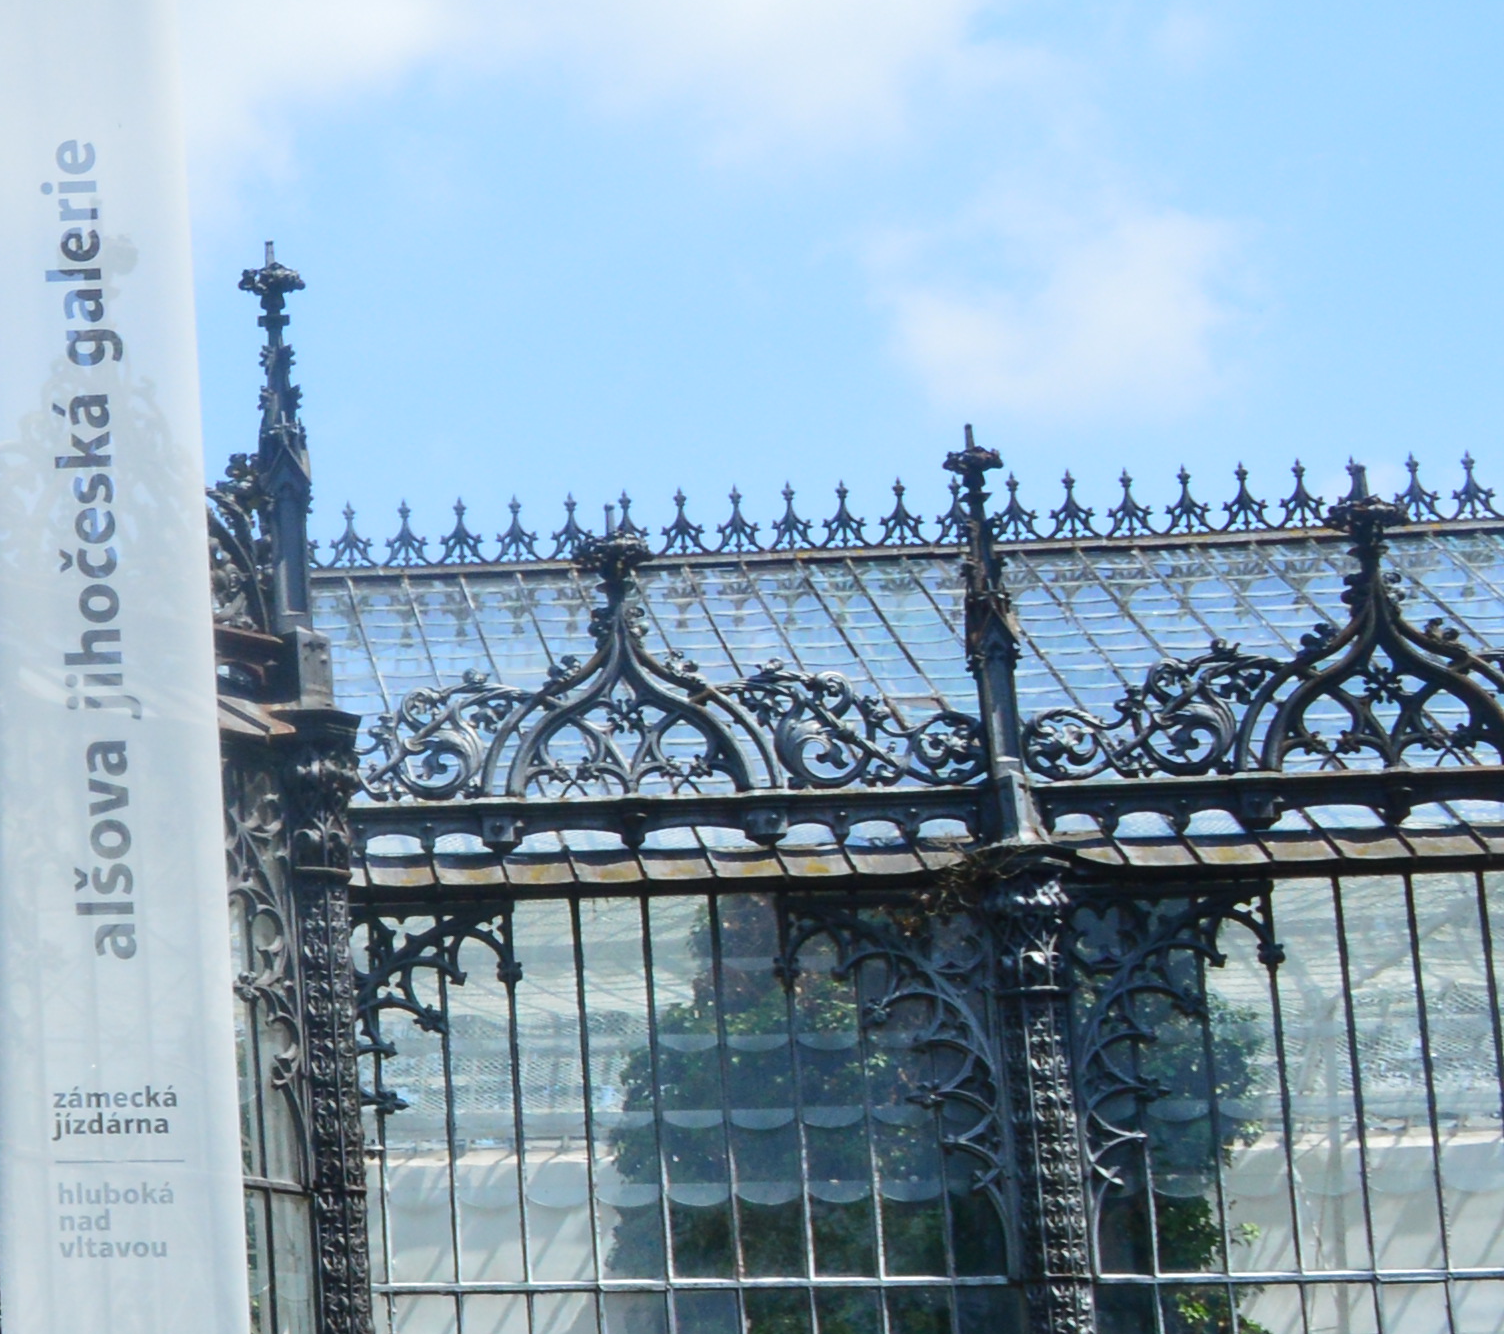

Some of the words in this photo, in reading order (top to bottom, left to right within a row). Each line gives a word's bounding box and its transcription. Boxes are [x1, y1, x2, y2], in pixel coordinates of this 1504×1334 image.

[40, 138, 123, 364] galerie
[52, 394, 142, 720] jihočeská
[74, 740, 137, 960] alšova
[53, 1085, 178, 1109] zámecká
[52, 1112, 169, 1141] jízdárna
[58, 1182, 174, 1205] hluboká
[59, 1209, 111, 1232] nad
[59, 1236, 168, 1258] vltavou
